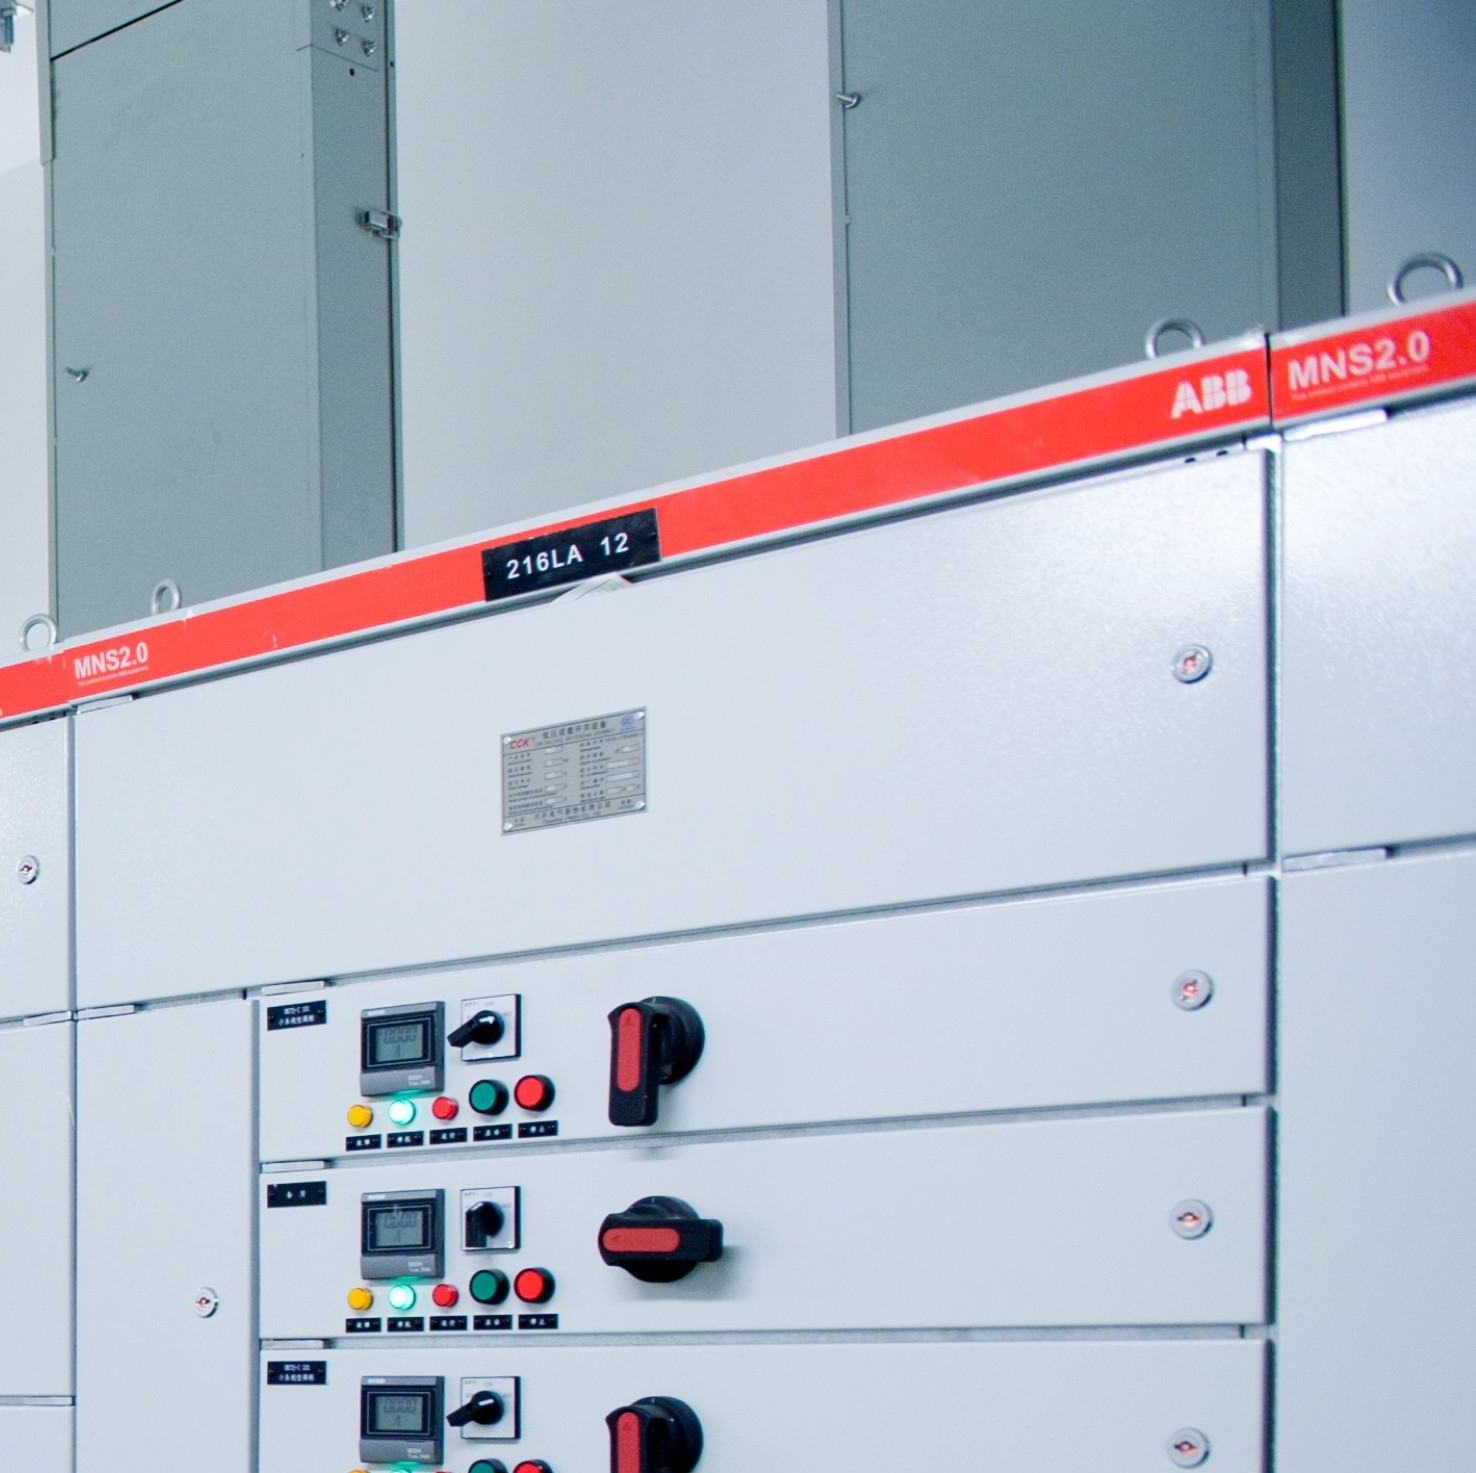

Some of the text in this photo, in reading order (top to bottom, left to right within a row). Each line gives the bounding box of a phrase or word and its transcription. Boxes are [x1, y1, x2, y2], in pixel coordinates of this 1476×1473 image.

[1287, 329, 1431, 392] MNS2.0
[1171, 368, 1252, 419] ABB
[505, 532, 630, 581] 216LA 12
[73, 641, 149, 680] MNS2.0
